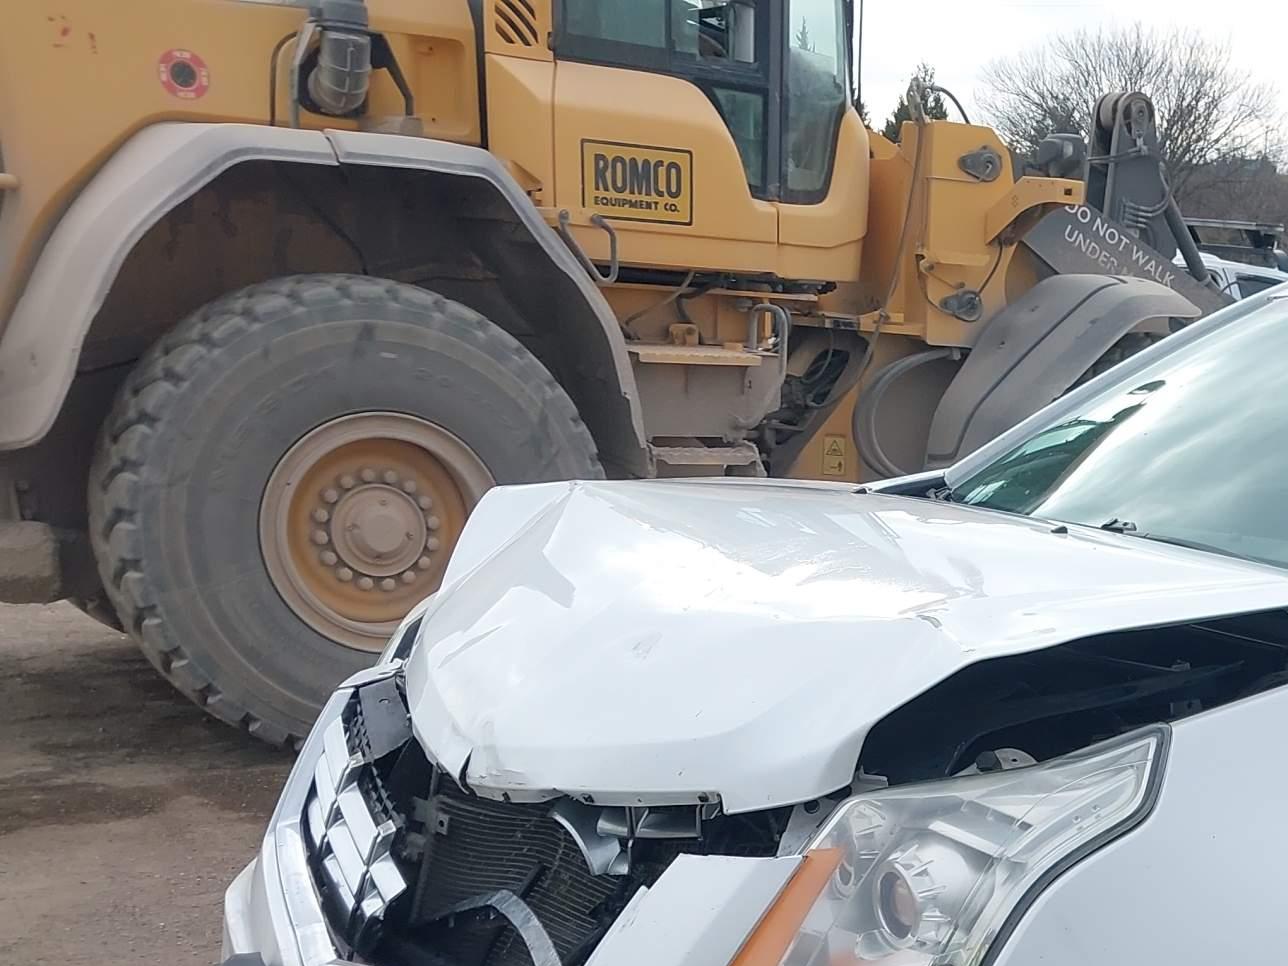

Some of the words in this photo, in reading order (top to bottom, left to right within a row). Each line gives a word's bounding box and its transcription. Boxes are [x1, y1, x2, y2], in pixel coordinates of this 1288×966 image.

[594, 153, 682, 199] ROMCO
[594, 196, 660, 211] EQUIPMENT
[664, 202, 680, 213] CO.
[1092, 217, 1130, 251] NOT
[1131, 245, 1175, 288] WALK
